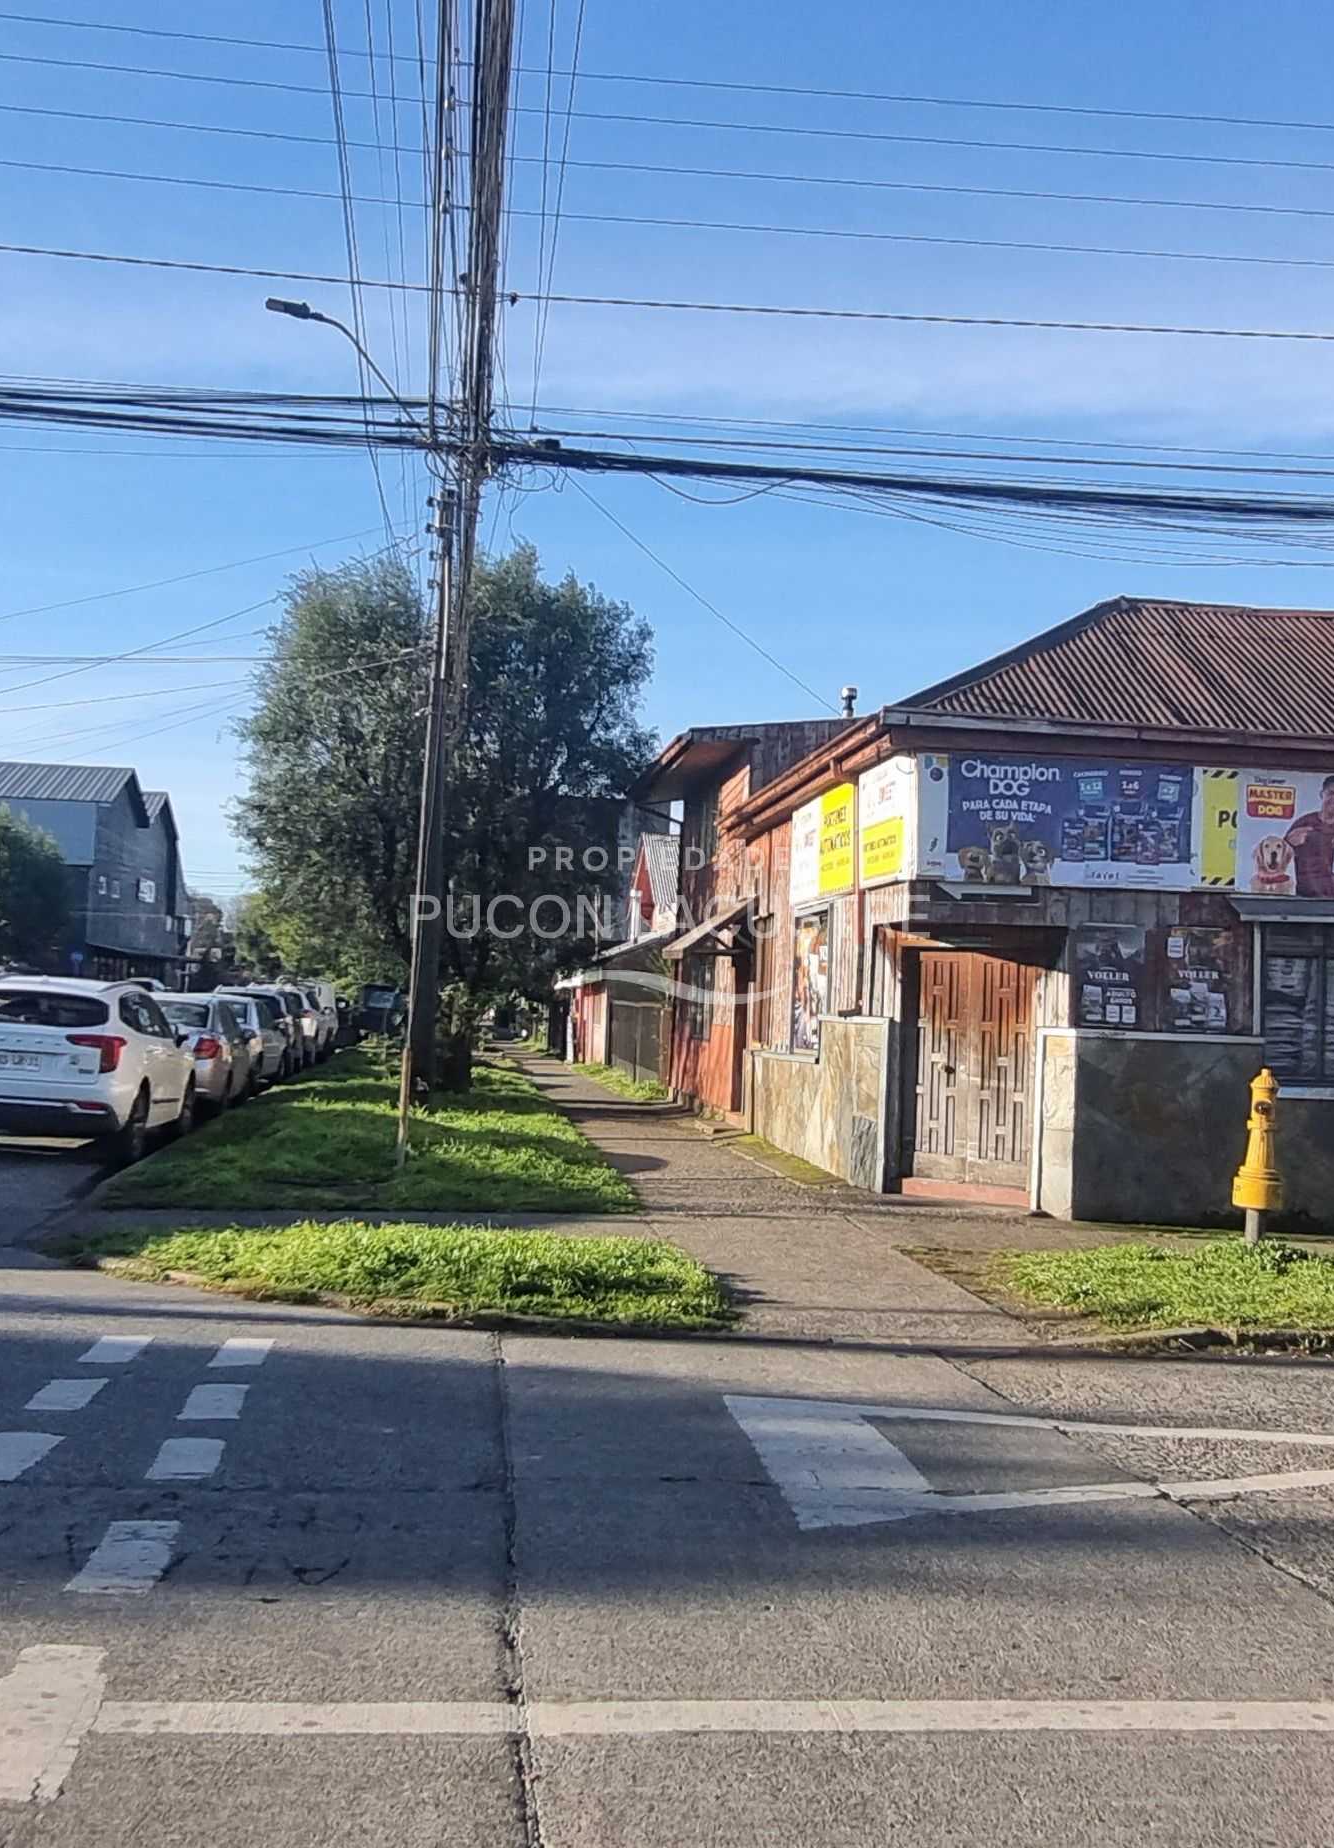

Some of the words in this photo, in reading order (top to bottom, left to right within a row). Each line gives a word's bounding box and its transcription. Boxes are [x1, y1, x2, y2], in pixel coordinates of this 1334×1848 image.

[961, 760, 1060, 783] Champion
[989, 779, 1030, 796] DOG
[1250, 788, 1293, 801] MASTER
[962, 799, 990, 811] PARA
[992, 799, 1018, 810] CADA
[1020, 801, 1052, 814] ETAPA
[1258, 805, 1283, 816] DOG
[979, 811, 994, 821] DE
[995, 811, 1009, 821] SU
[1087, 970, 1130, 981] VOLLER
